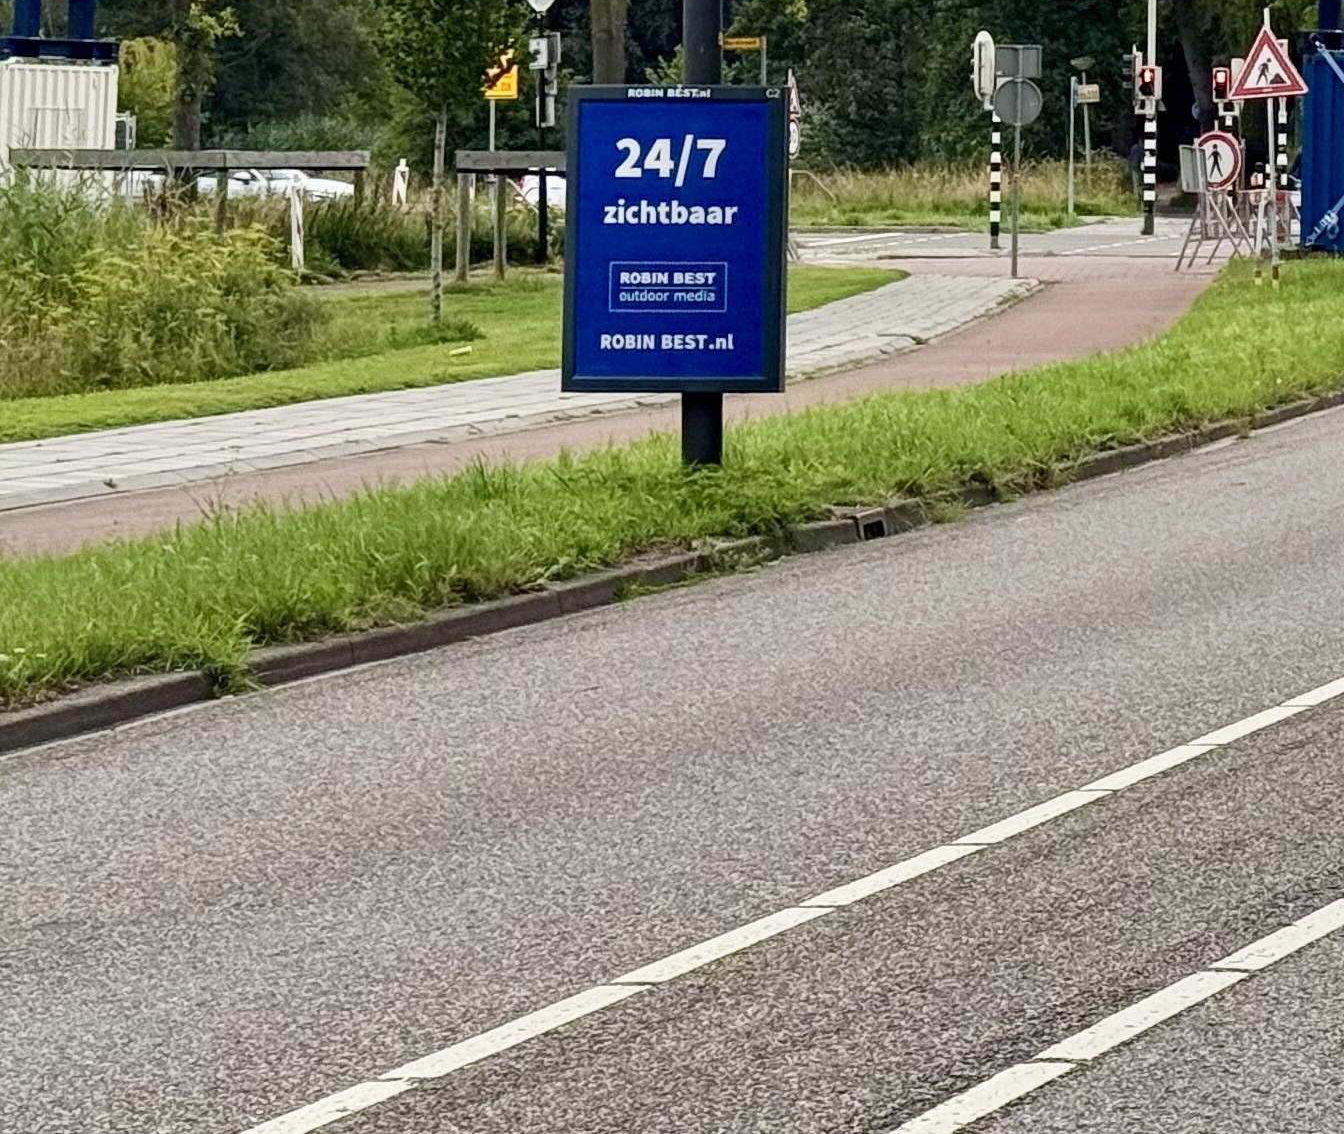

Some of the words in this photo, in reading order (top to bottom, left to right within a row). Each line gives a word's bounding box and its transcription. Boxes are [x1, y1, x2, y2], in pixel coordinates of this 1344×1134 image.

[627, 88, 664, 98] ROBIN
[667, 88, 711, 98] BEST.nl
[615, 134, 726, 187] 24/7
[603, 199, 738, 224] zichtbaar
[620, 272, 669, 284] ROBIN
[673, 272, 716, 284] BEST
[619, 290, 669, 302] outdoor
[673, 290, 716, 302] media
[600, 334, 655, 350] ROBIN
[661, 333, 734, 350] BEST.nl
